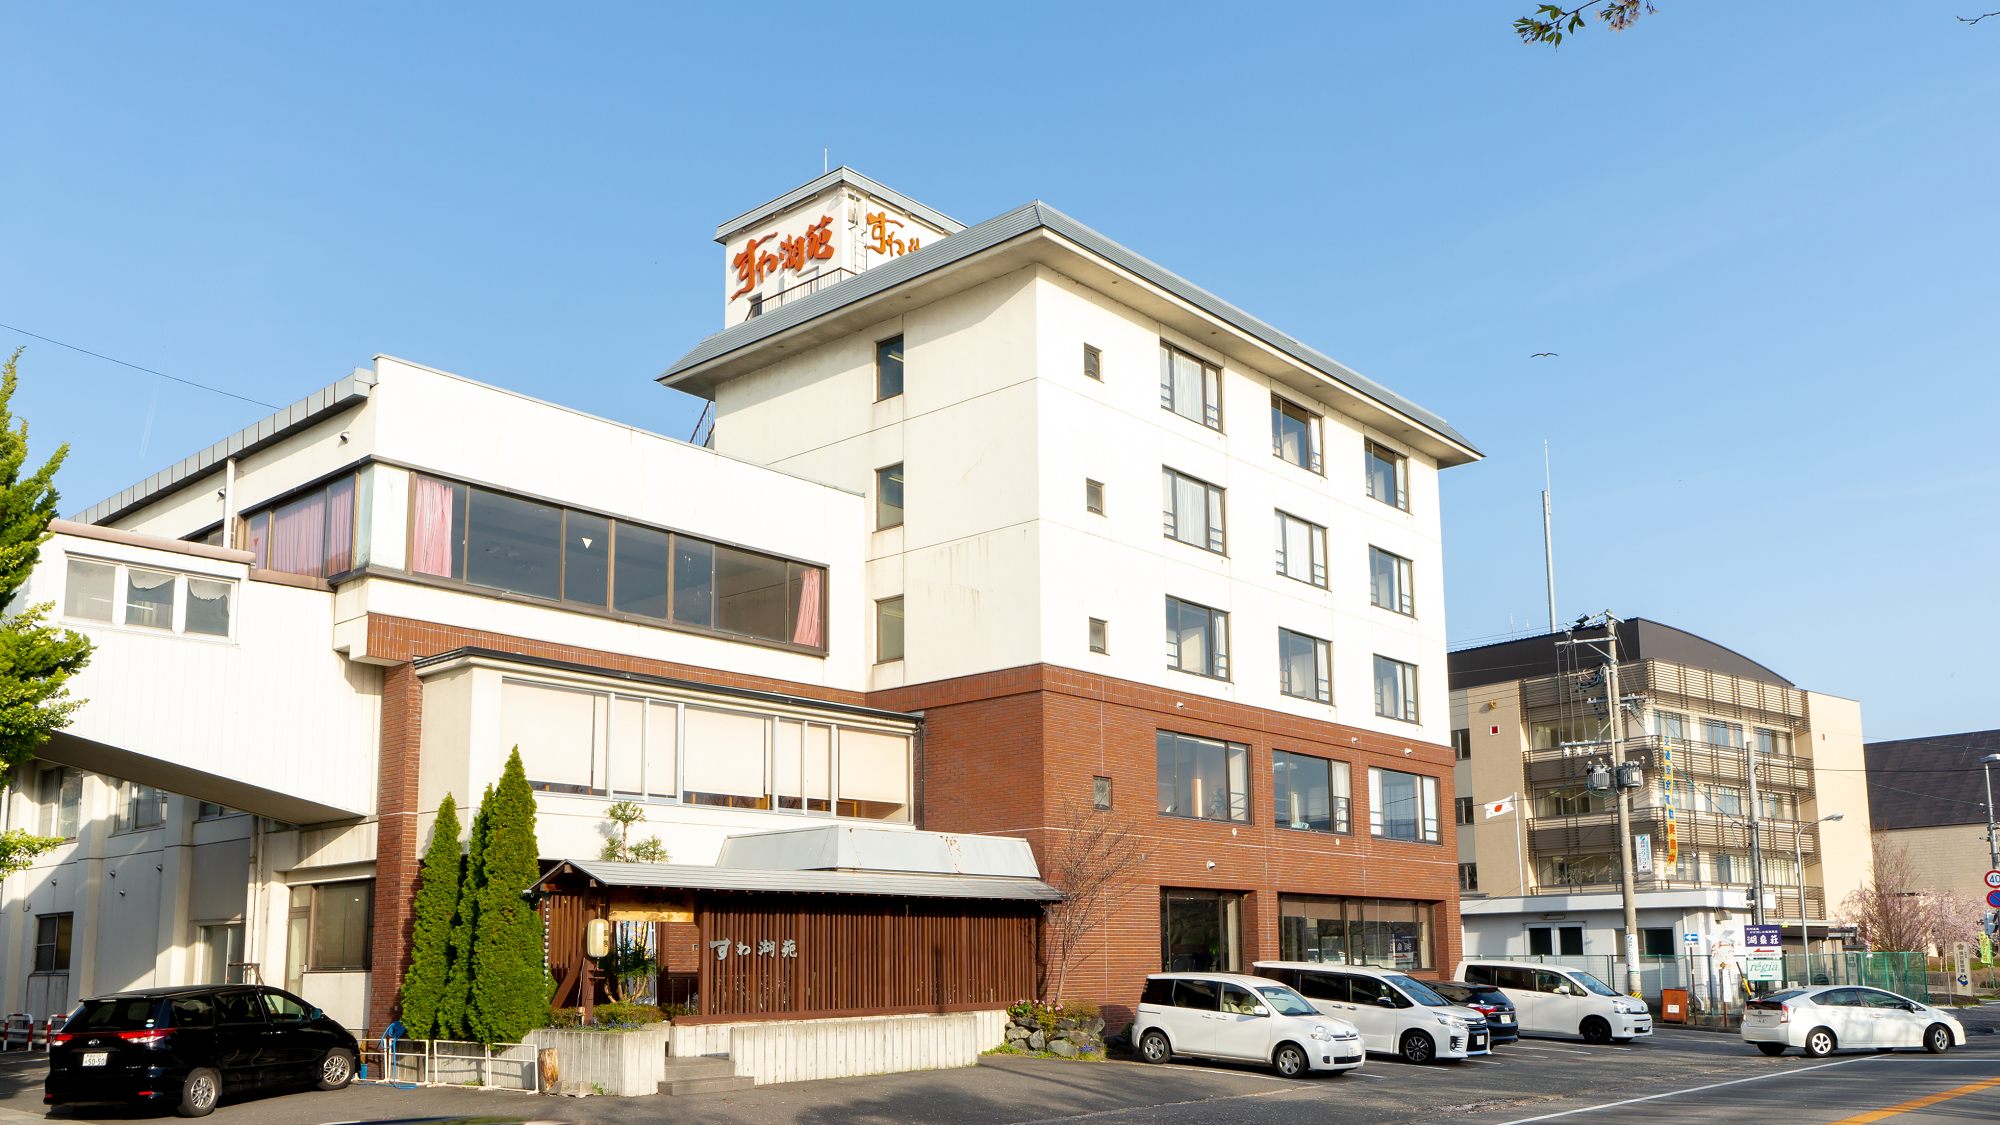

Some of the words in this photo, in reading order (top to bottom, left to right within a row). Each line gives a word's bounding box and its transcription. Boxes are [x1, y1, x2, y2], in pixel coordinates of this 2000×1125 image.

[731, 214, 835, 301] すわ湖苑
[709, 938, 798, 960] すわ湖苑
